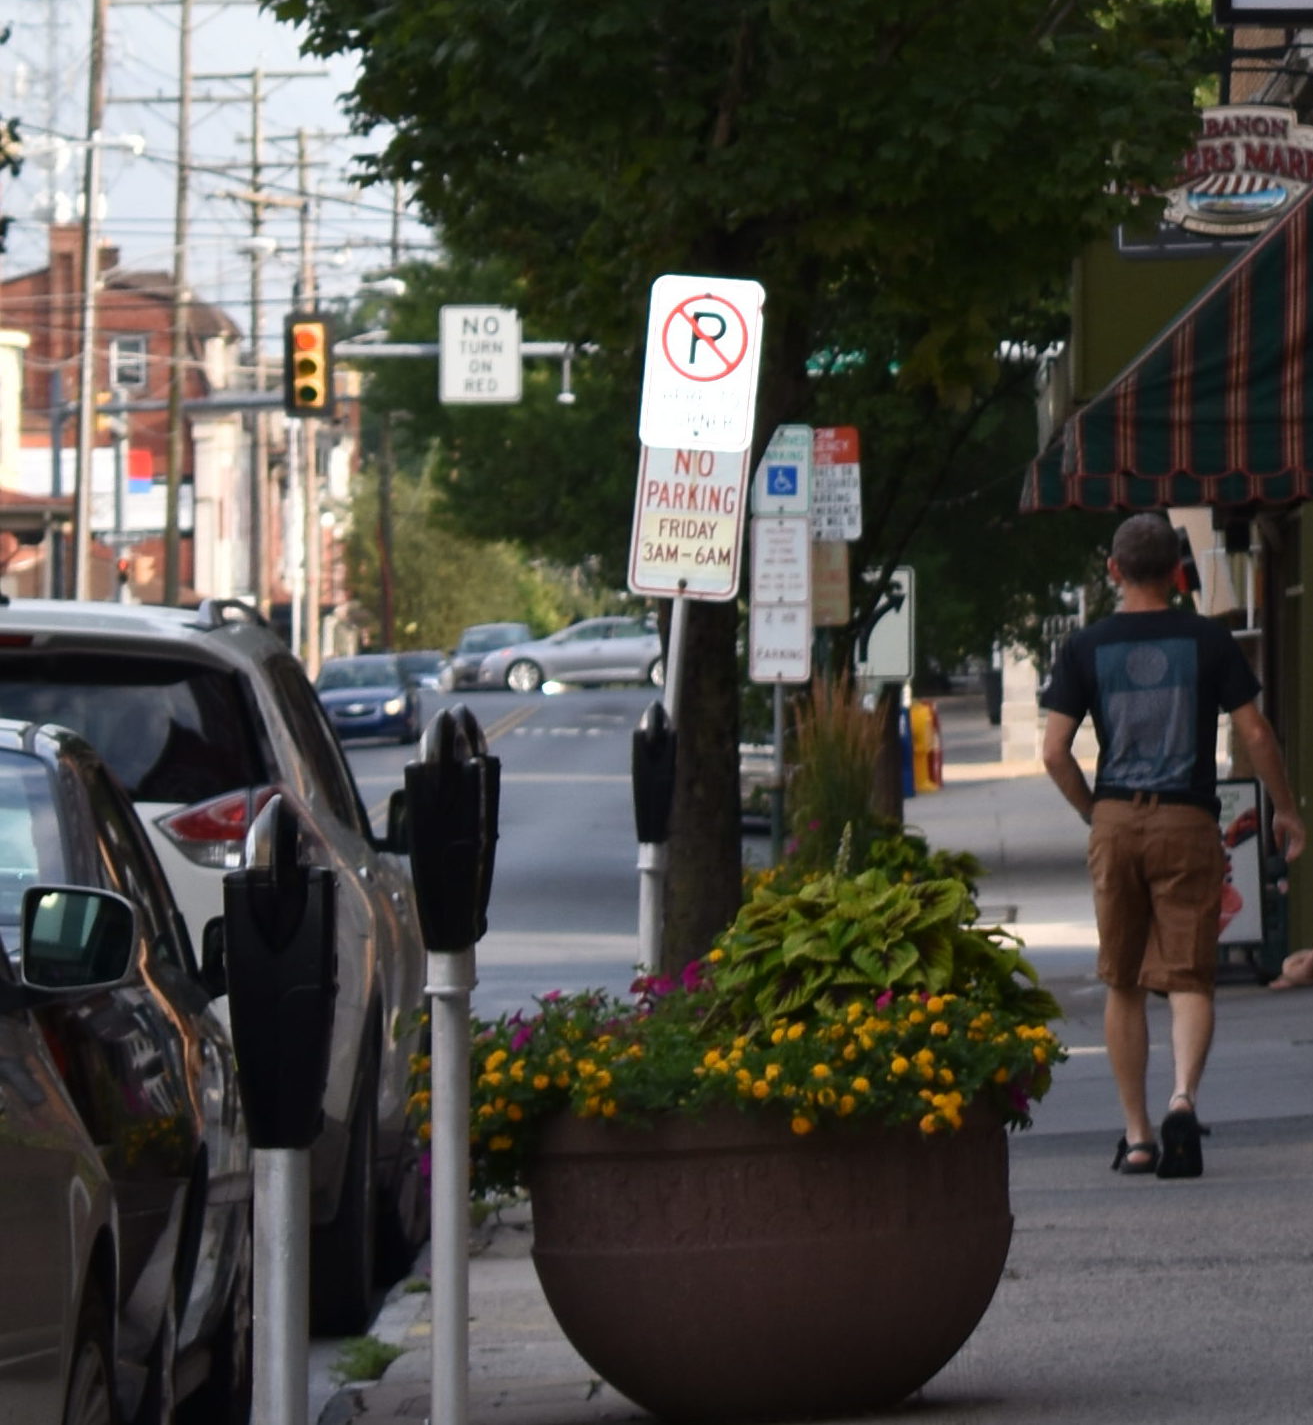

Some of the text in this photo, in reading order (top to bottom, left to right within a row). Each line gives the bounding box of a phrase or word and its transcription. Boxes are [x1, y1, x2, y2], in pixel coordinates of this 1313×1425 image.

[462, 316, 500, 335] NO
[459, 340, 504, 354] TURN
[468, 359, 493, 373] ON
[464, 378, 498, 392] RED
[675, 448, 715, 478] NO
[646, 481, 736, 515] PARKING
[658, 518, 717, 541] FRIDAY
